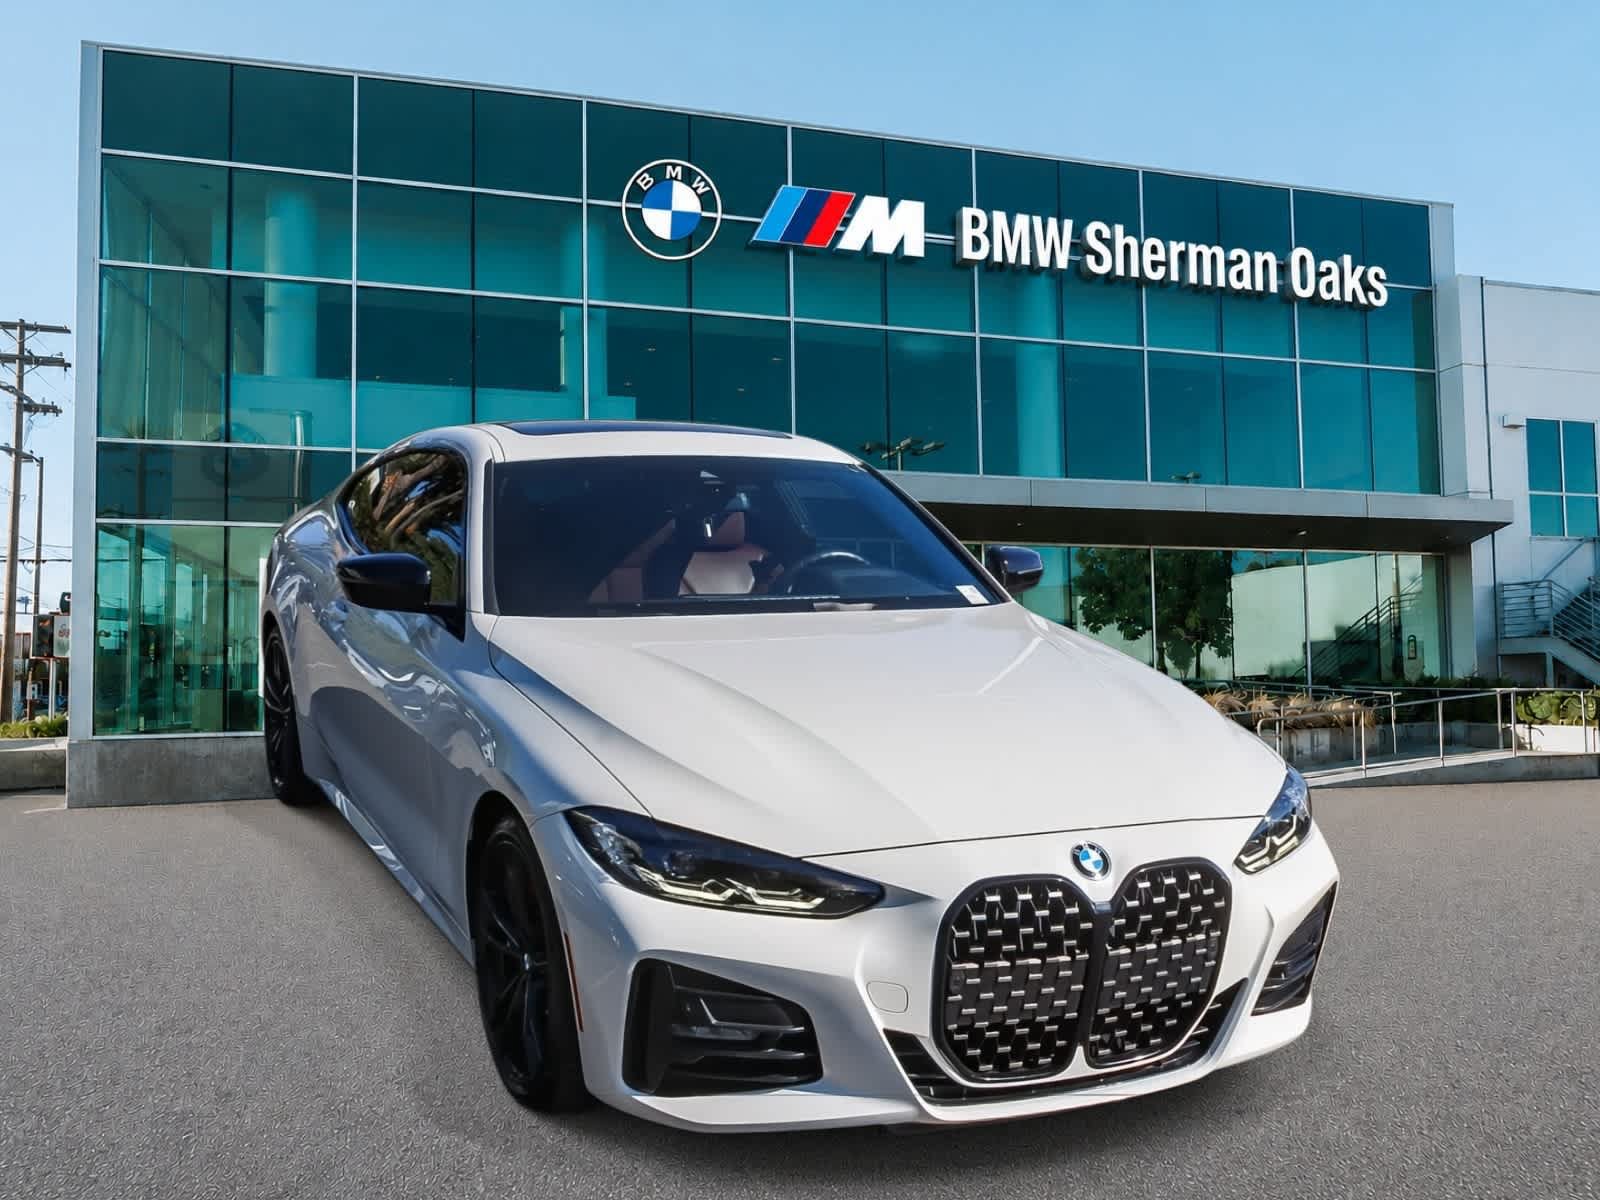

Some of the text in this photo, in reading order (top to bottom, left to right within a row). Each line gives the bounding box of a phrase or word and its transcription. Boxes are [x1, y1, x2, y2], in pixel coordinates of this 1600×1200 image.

[636, 164, 711, 196] BMW
[836, 195, 925, 257] M
[961, 206, 1389, 308] BMW Sherman Oaks
